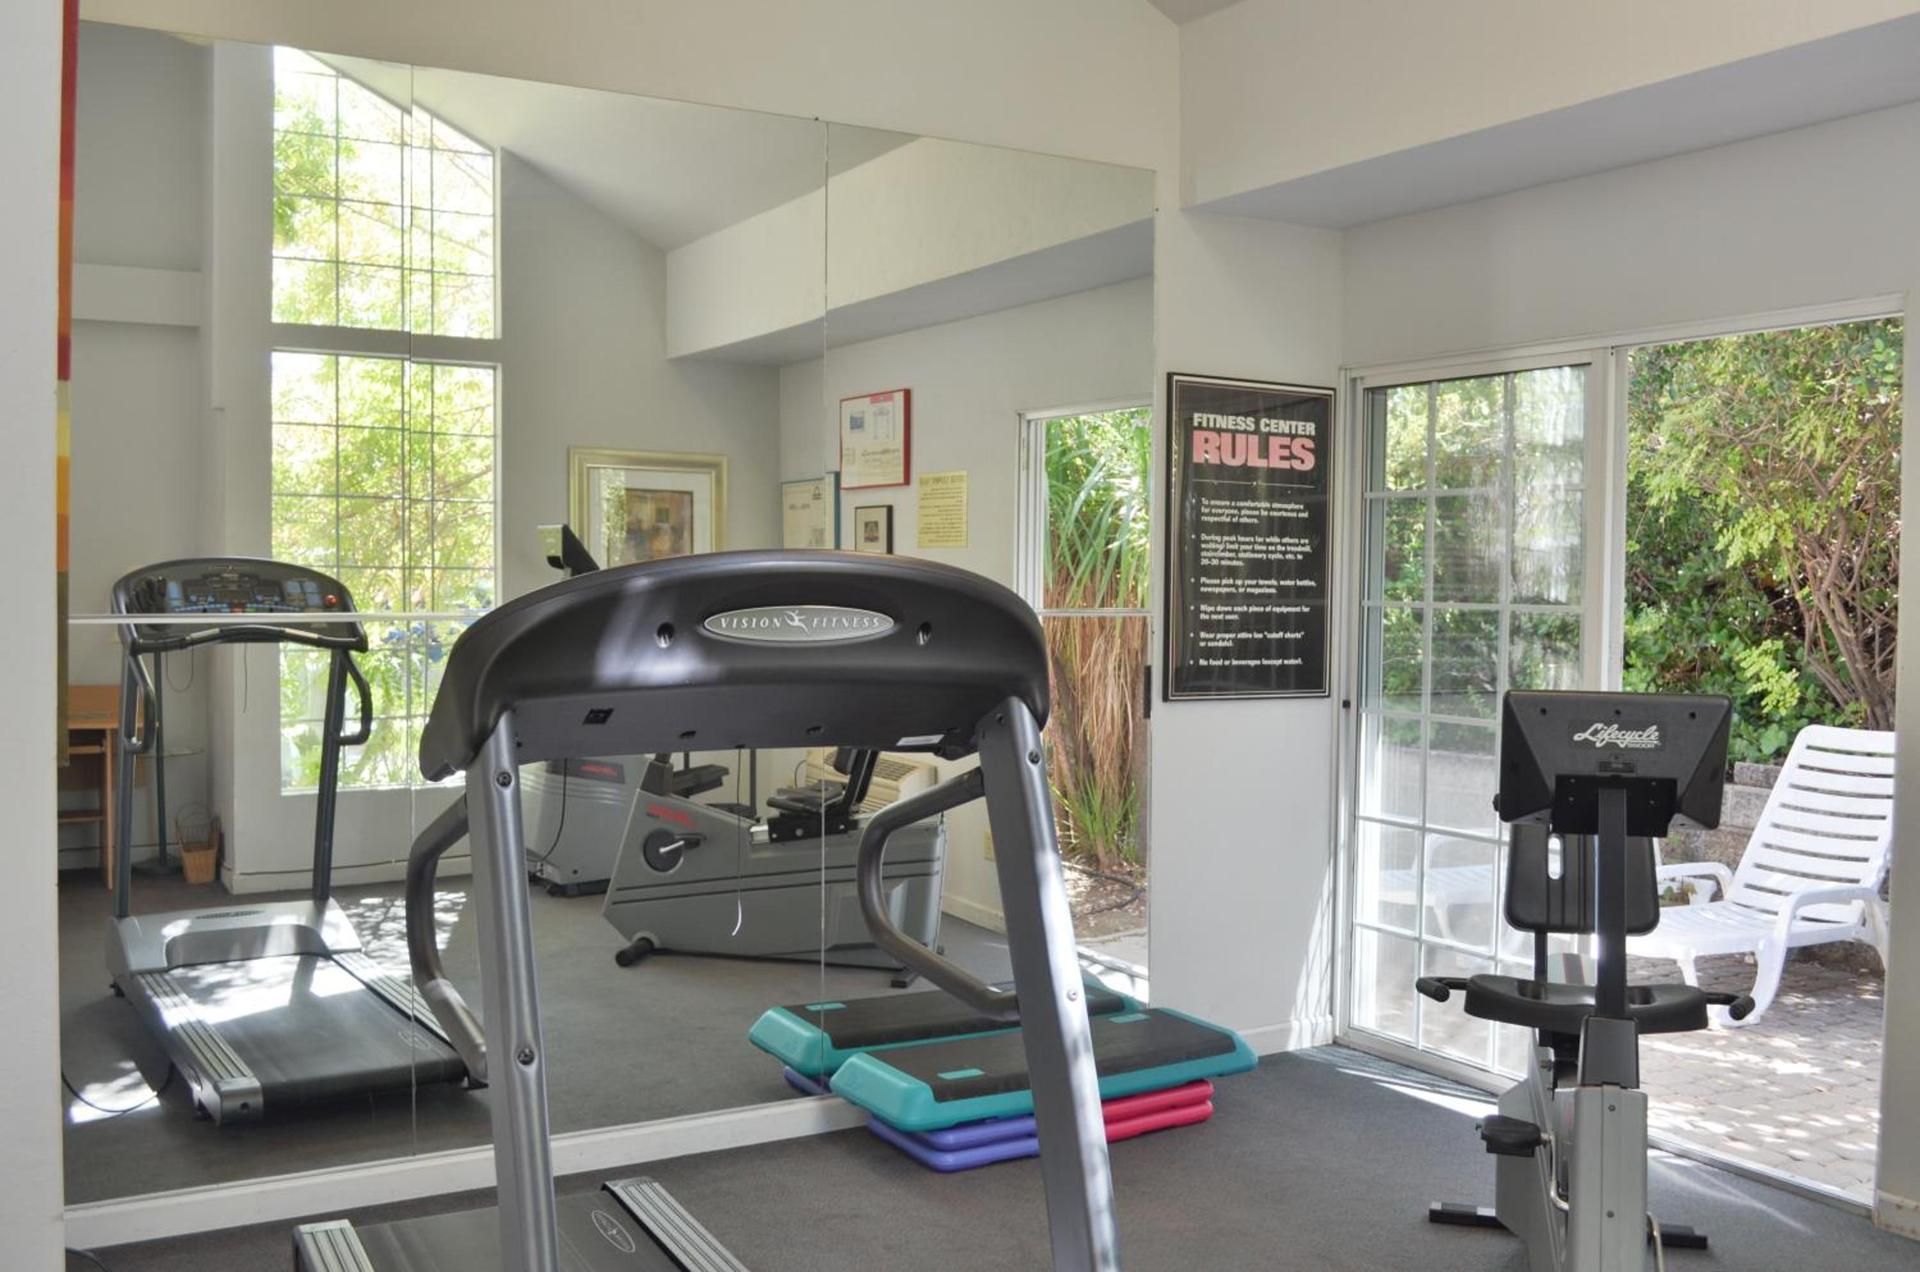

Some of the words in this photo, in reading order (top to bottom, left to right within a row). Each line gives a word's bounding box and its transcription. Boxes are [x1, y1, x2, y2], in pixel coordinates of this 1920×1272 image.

[1193, 412, 1256, 432] FITNESS
[1260, 418, 1316, 437] CENTER
[1192, 429, 1316, 472] RULES
[1236, 499, 1270, 508] comfortable
[1271, 501, 1304, 511] atmosphere
[1201, 505, 1210, 513] for
[1240, 509, 1259, 517] please
[1260, 508, 1268, 516] be
[1269, 510, 1297, 518] courteous
[1232, 515, 1239, 523] of
[1201, 533, 1221, 544] During
[1222, 534, 1236, 543] peak
[1237, 534, 1254, 542] hours
[1265, 536, 1281, 544] while
[1281, 537, 1299, 545] others
[1225, 542, 1238, 550] limit
[1239, 544, 1253, 552] your
[1253, 543, 1267, 551] time
[1238, 551, 1267, 560] stationary
[1267, 552, 1284, 560] cycle,
[1200, 576, 1220, 585] Please
[1221, 576, 1234, 586] pick
[1234, 578, 1244, 586] up
[1257, 578, 1278, 586] towels,
[1279, 578, 1296, 586] water
[1296, 578, 1317, 587] bottles,
[1200, 586, 1237, 594] newspapers,
[1246, 587, 1277, 595] magazines.
[1200, 604, 1216, 613] Wipe
[1248, 605, 1264, 614] piece
[1272, 605, 1301, 614] equipment
[720, 617, 782, 629] VISION
[812, 617, 880, 628] FITNESS
[1200, 631, 1216, 639] Wear
[1216, 632, 1236, 640] proper
[1236, 631, 1253, 639] attire
[1209, 658, 1223, 666] food
[1231, 658, 1261, 667] beverages
[1573, 723, 1661, 748] Lifecycle
